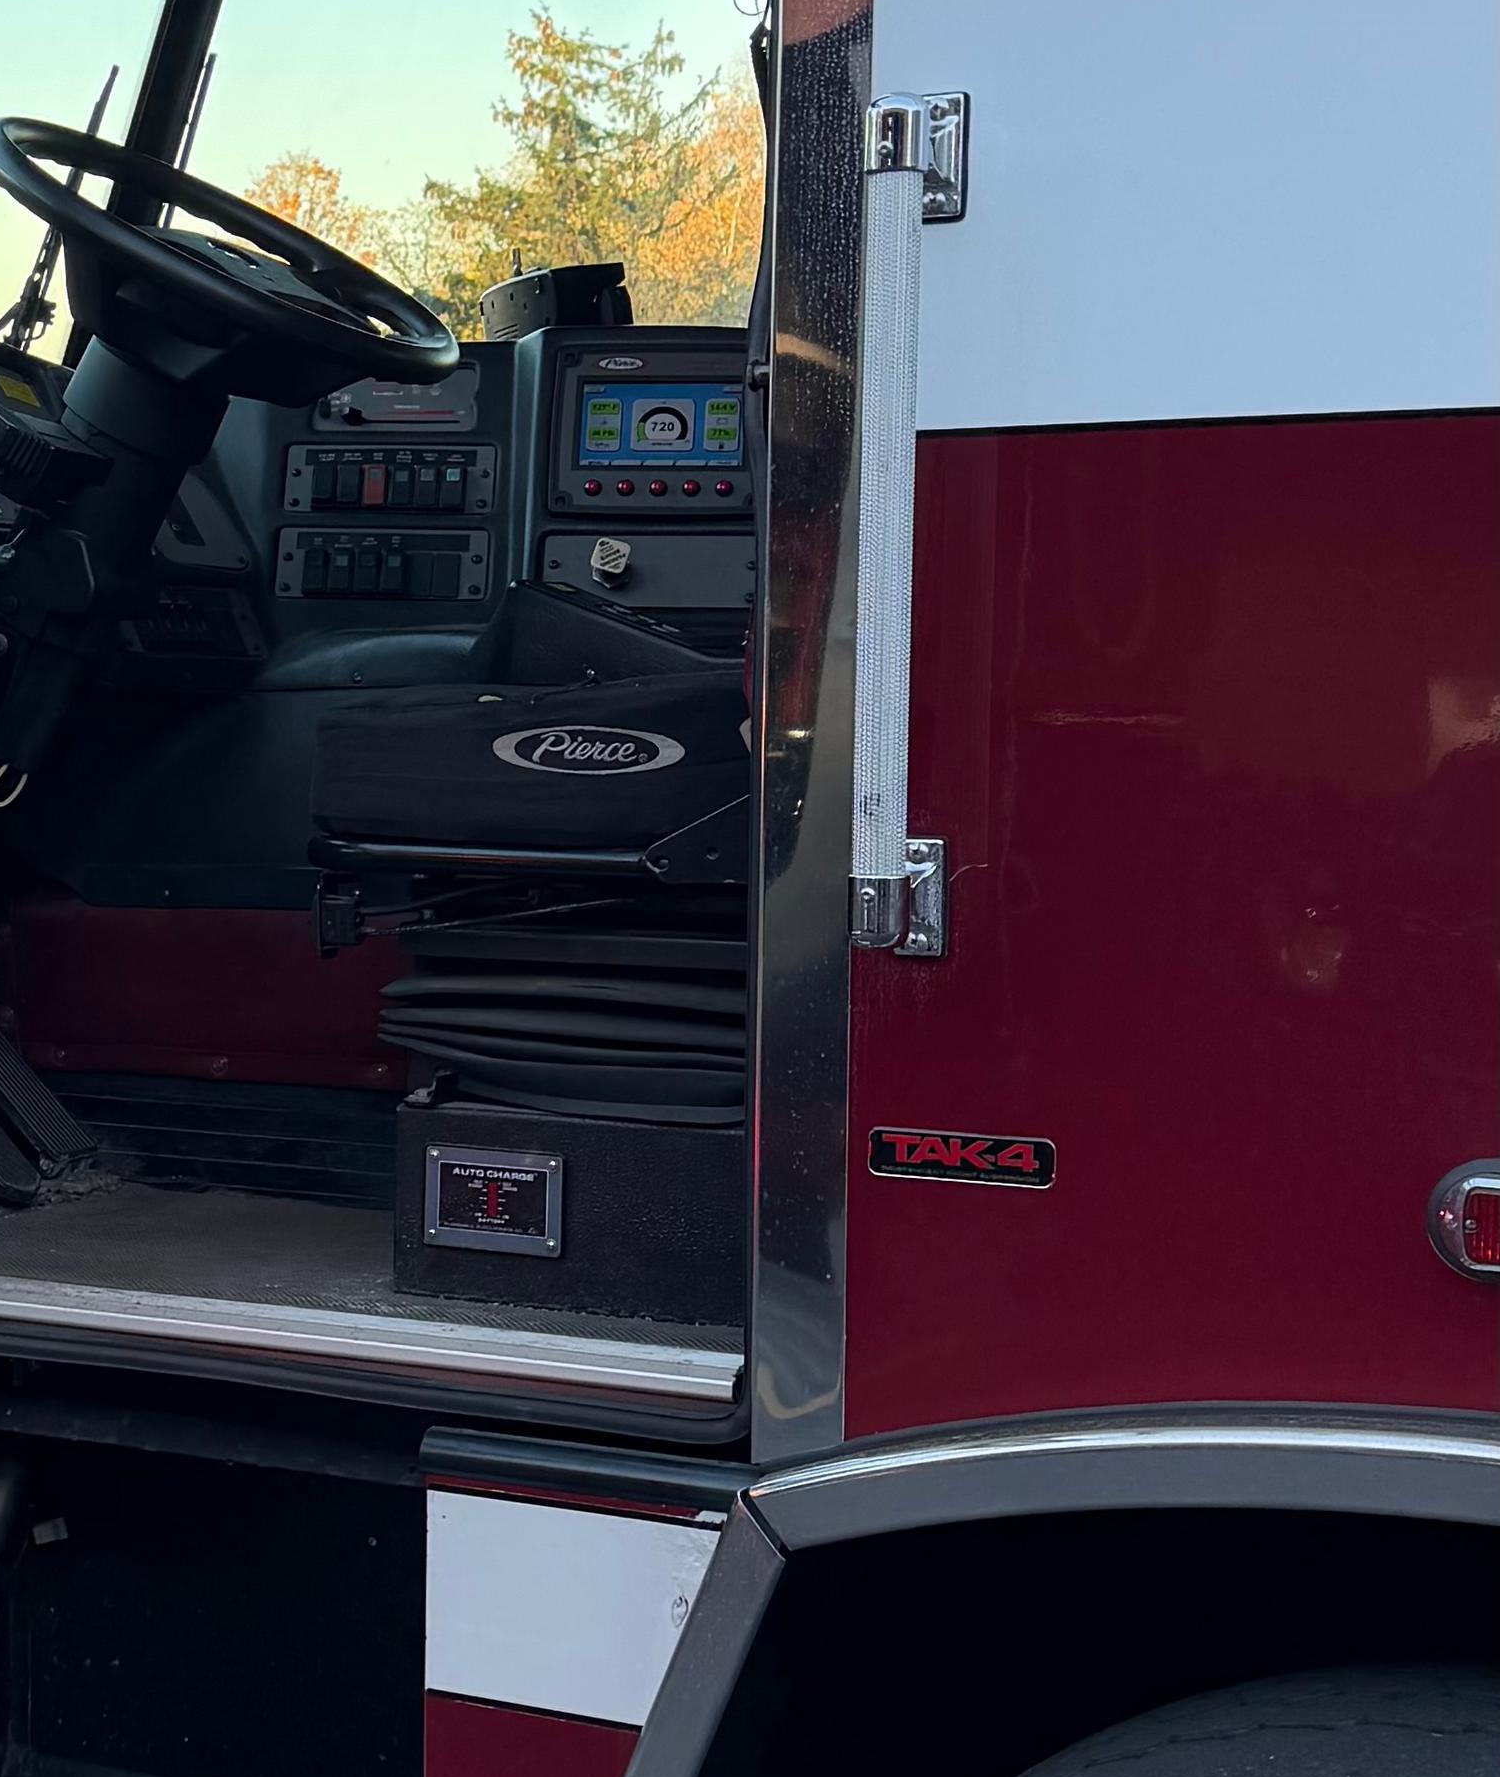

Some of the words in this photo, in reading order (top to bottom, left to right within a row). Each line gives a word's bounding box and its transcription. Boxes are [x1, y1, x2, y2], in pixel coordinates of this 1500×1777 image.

[651, 422, 675, 432] 720
[531, 731, 637, 763] Pierce
[882, 1133, 1040, 1173] TAK-4
[452, 1167, 484, 1178] AUTO
[486, 1170, 535, 1182] CHARGE
